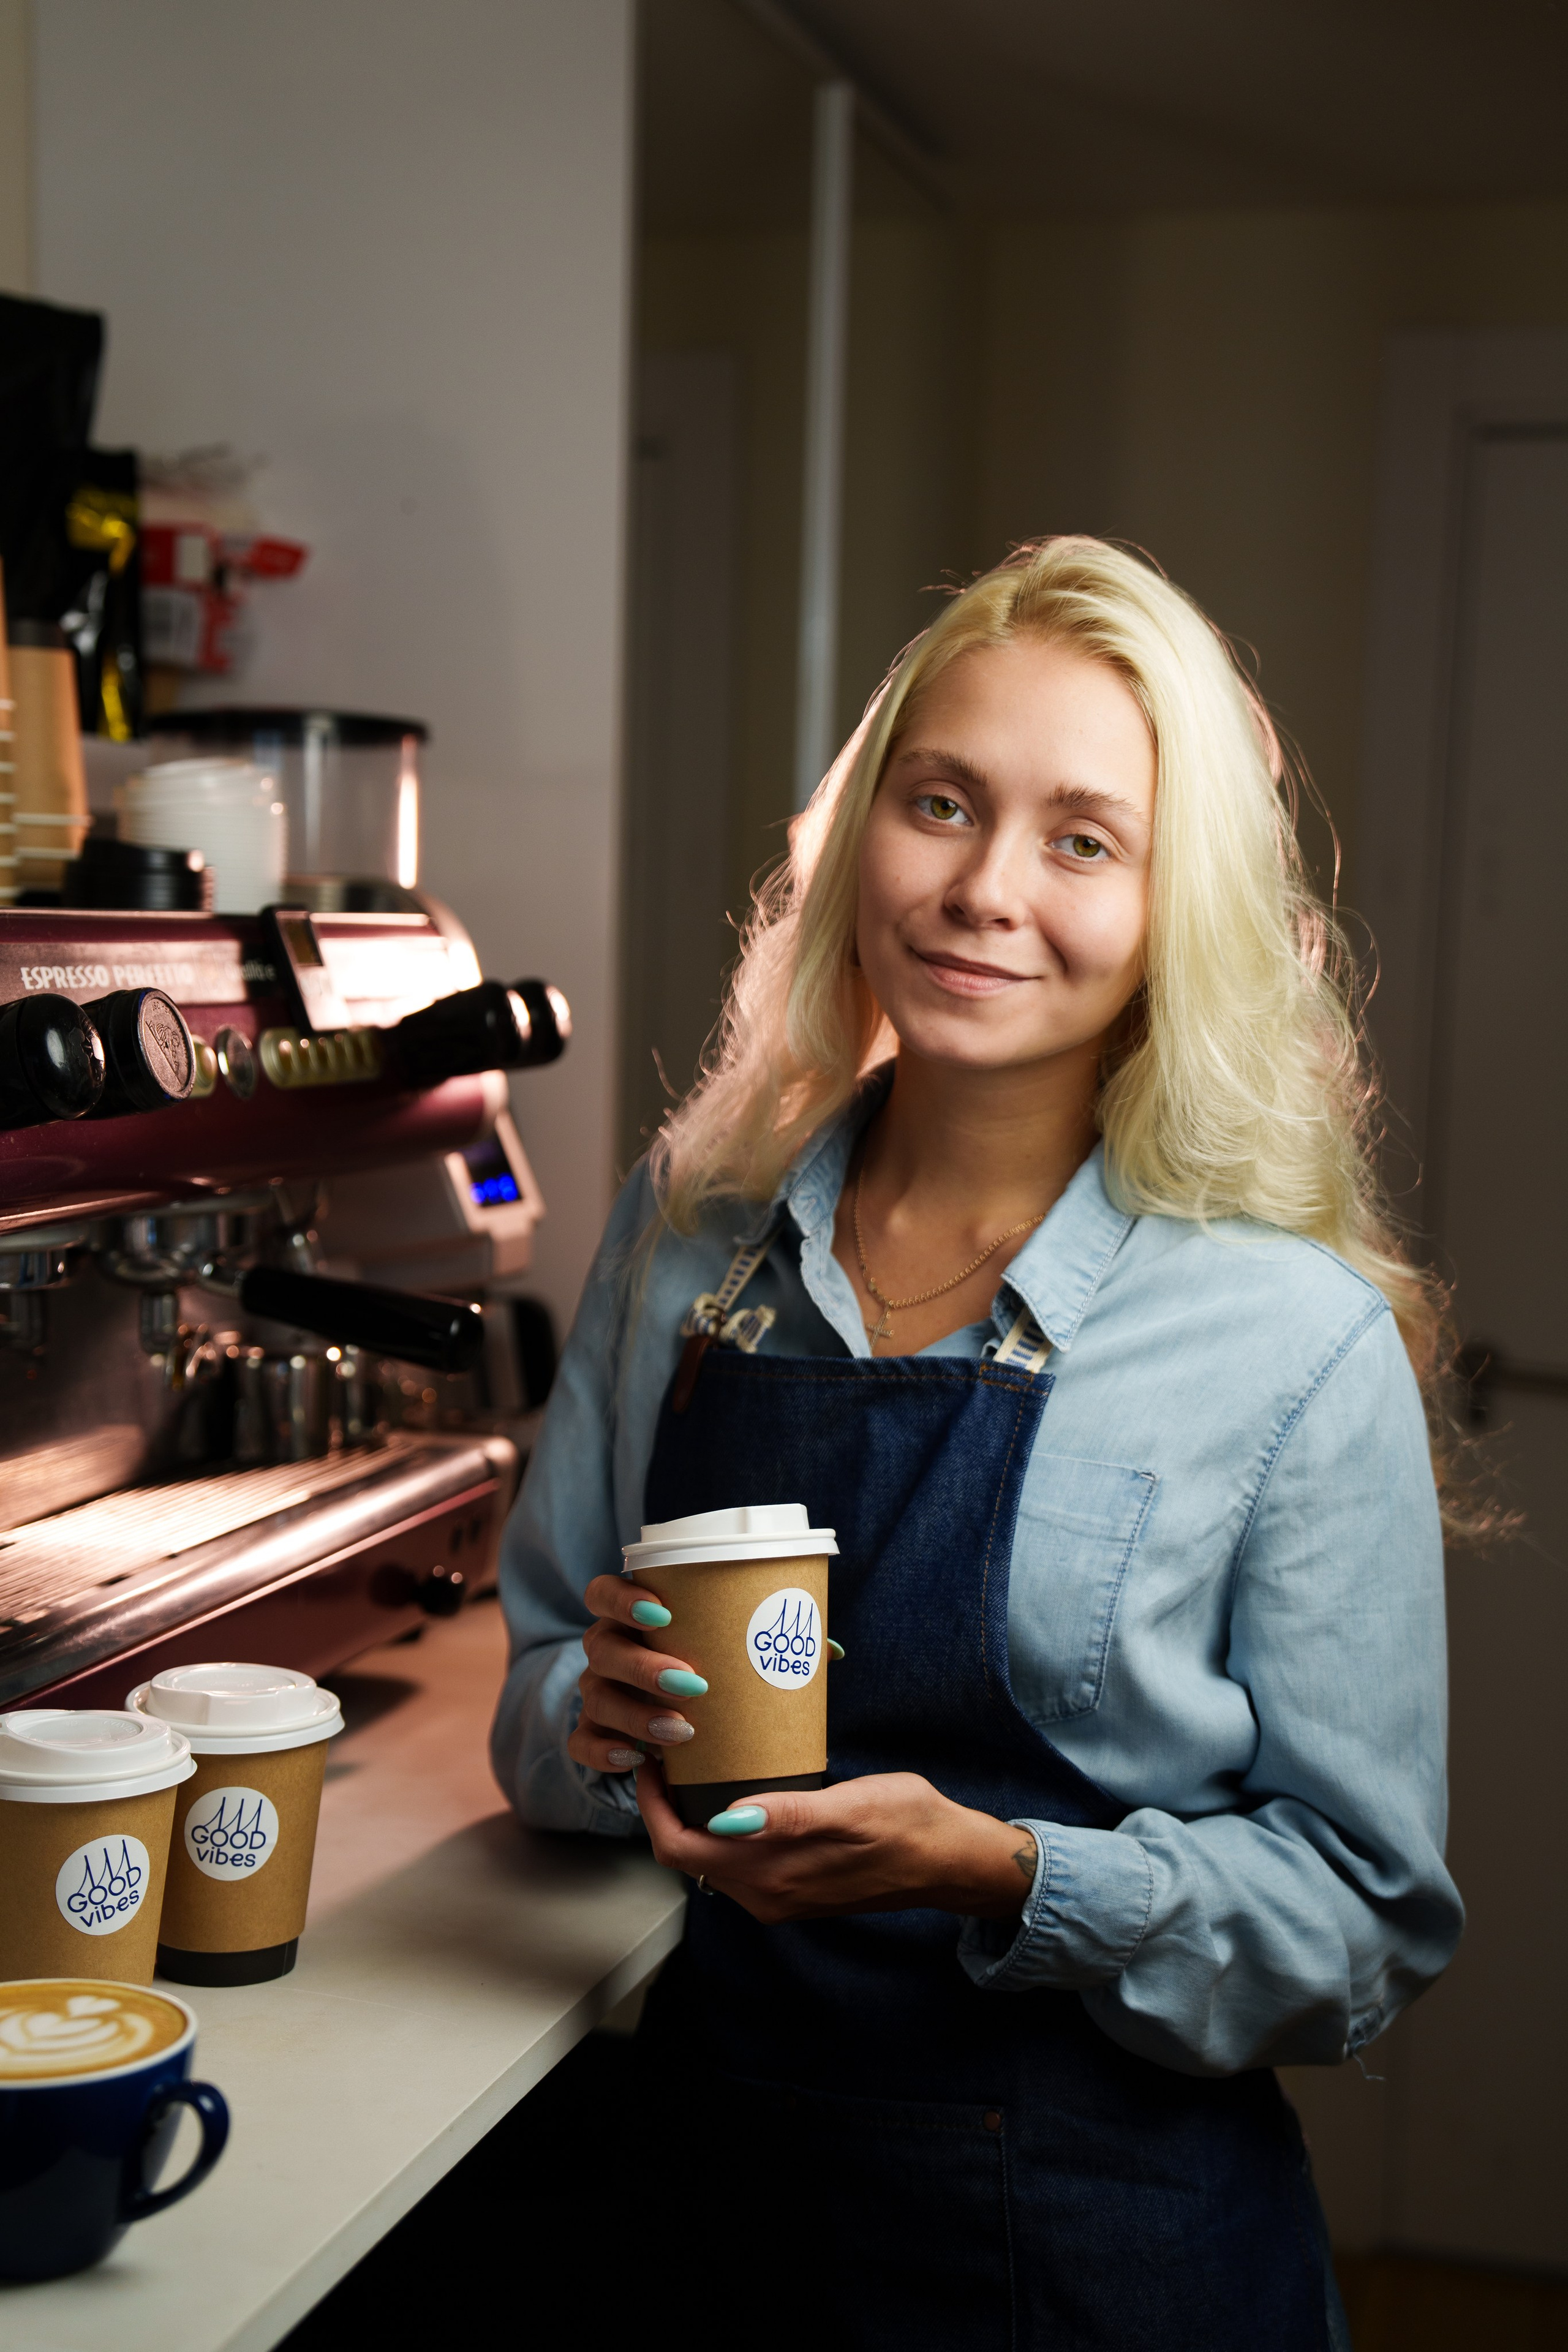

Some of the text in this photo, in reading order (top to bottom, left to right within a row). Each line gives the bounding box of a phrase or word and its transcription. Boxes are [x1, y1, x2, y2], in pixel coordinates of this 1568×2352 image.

[21, 964, 111, 990] ESPRESSO
[754, 1630, 816, 1657] GOOD
[760, 1653, 810, 1676] vibes
[191, 1825, 266, 1850] GOOD
[196, 1846, 256, 1868] vibes
[67, 1866, 141, 1913] GOOD
[79, 1890, 140, 1928] vibes
